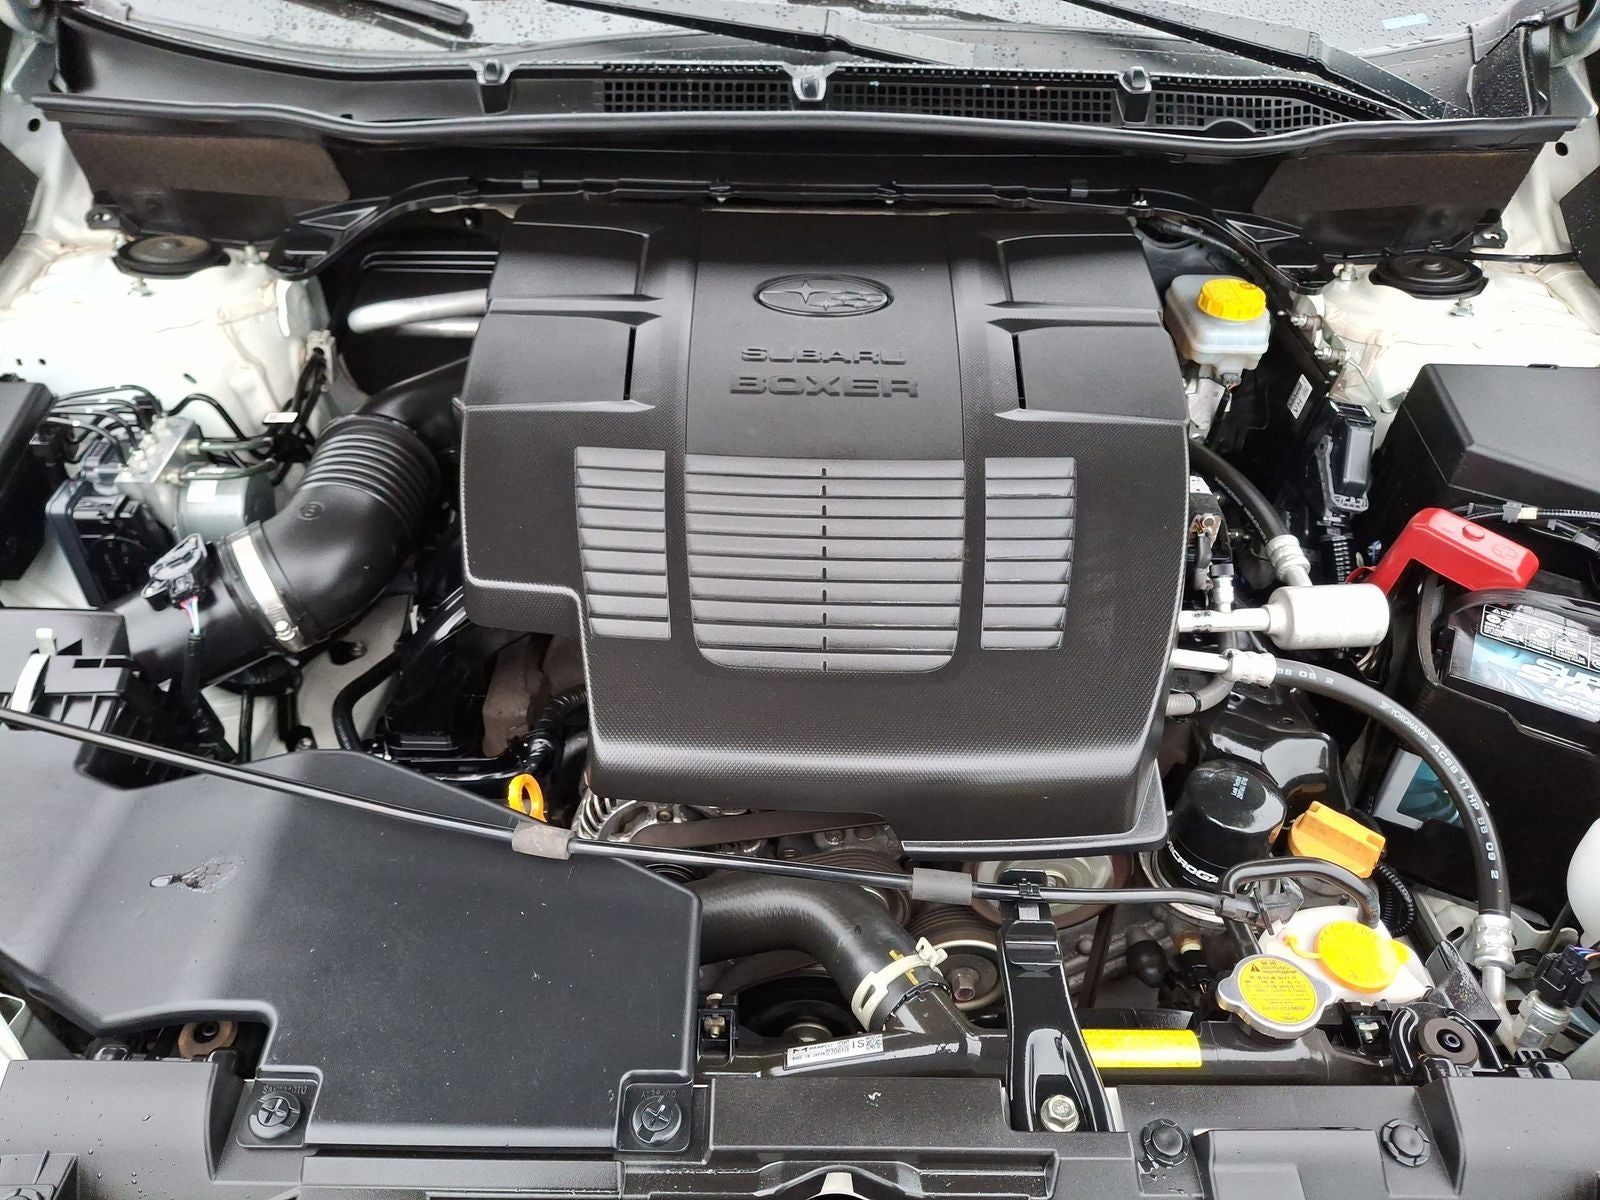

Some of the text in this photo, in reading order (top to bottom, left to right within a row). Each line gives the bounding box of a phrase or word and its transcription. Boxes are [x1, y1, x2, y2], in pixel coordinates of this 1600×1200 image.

[741, 348, 907, 366] SUBARU
[729, 375, 919, 398] BOXER
[1389, 705, 1429, 741] YOKOHAMA
[1459, 779, 1471, 791] 11
[1467, 793, 1480, 811] HP
[1490, 869, 1500, 880] 2
